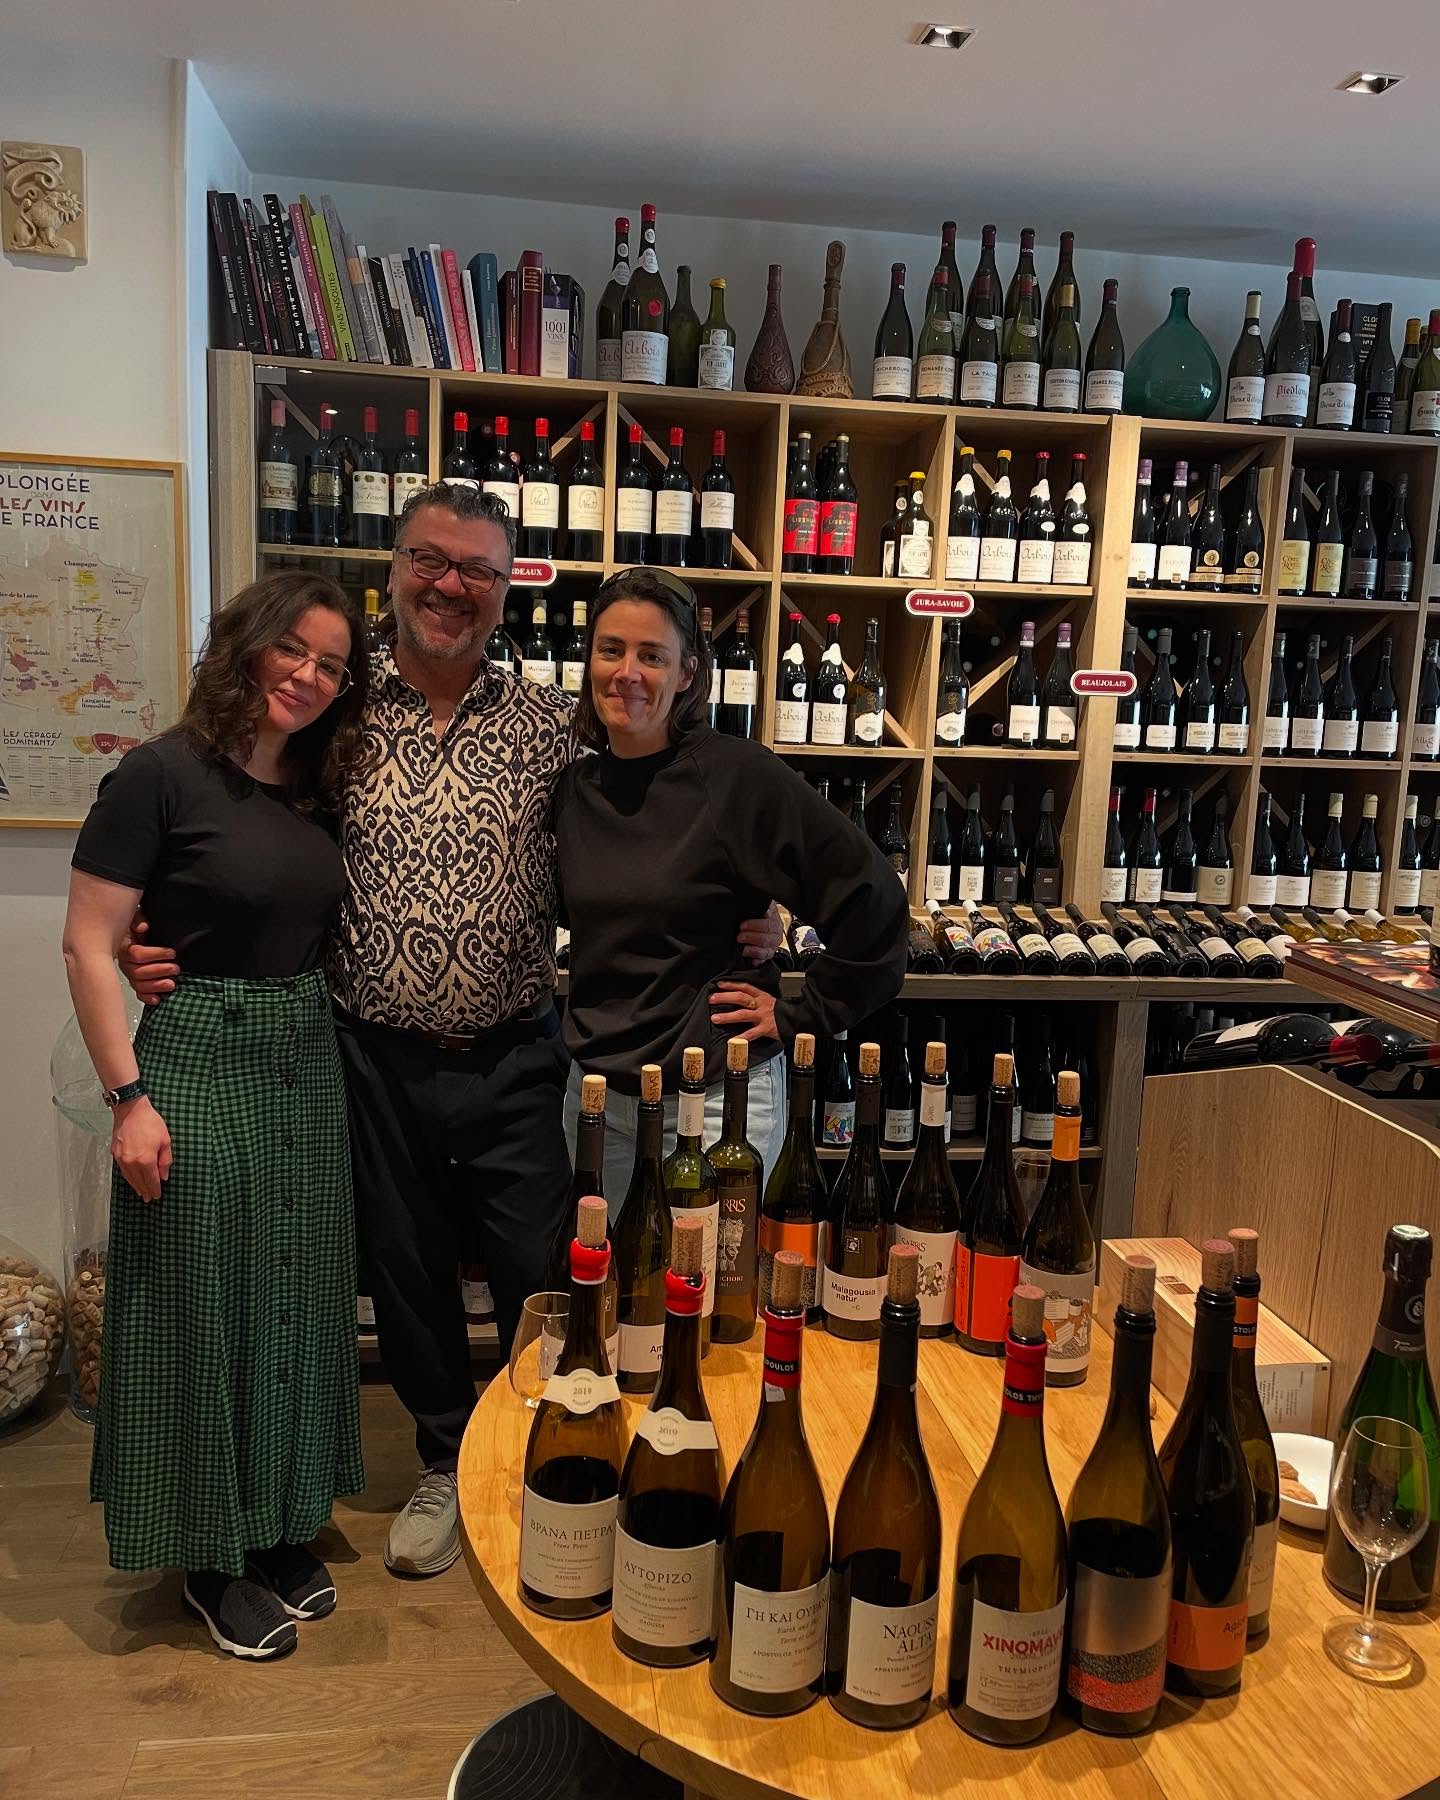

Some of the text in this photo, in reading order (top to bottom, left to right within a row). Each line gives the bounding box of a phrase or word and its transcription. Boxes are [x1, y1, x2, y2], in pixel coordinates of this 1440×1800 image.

[285, 277, 292, 289] DU
[290, 297, 300, 327] RHUM
[327, 272, 345, 333] VINS INSOLITES
[544, 320, 568, 334] 1001
[546, 333, 565, 341] VINS
[0, 497, 87, 514] LES VINS
[2, 511, 100, 530] E FRANCE
[64, 560, 99, 572] Champagne
[512, 567, 542, 576] DEAUX
[915, 598, 965, 609] JURA-SAVOIE
[1081, 679, 1127, 688] BEAUJOLAIS
[23, 730, 63, 741] CÉPAGES
[4, 738, 56, 748] DOMINANTS
[723, 1198, 746, 1213] RRIS
[831, 1281, 876, 1297] Malagousia
[836, 1293, 857, 1303] natur
[765, 1358, 795, 1372] POULOS
[883, 1616, 936, 1640] NAOUSS
[982, 1625, 1063, 1657] XINOMAV
